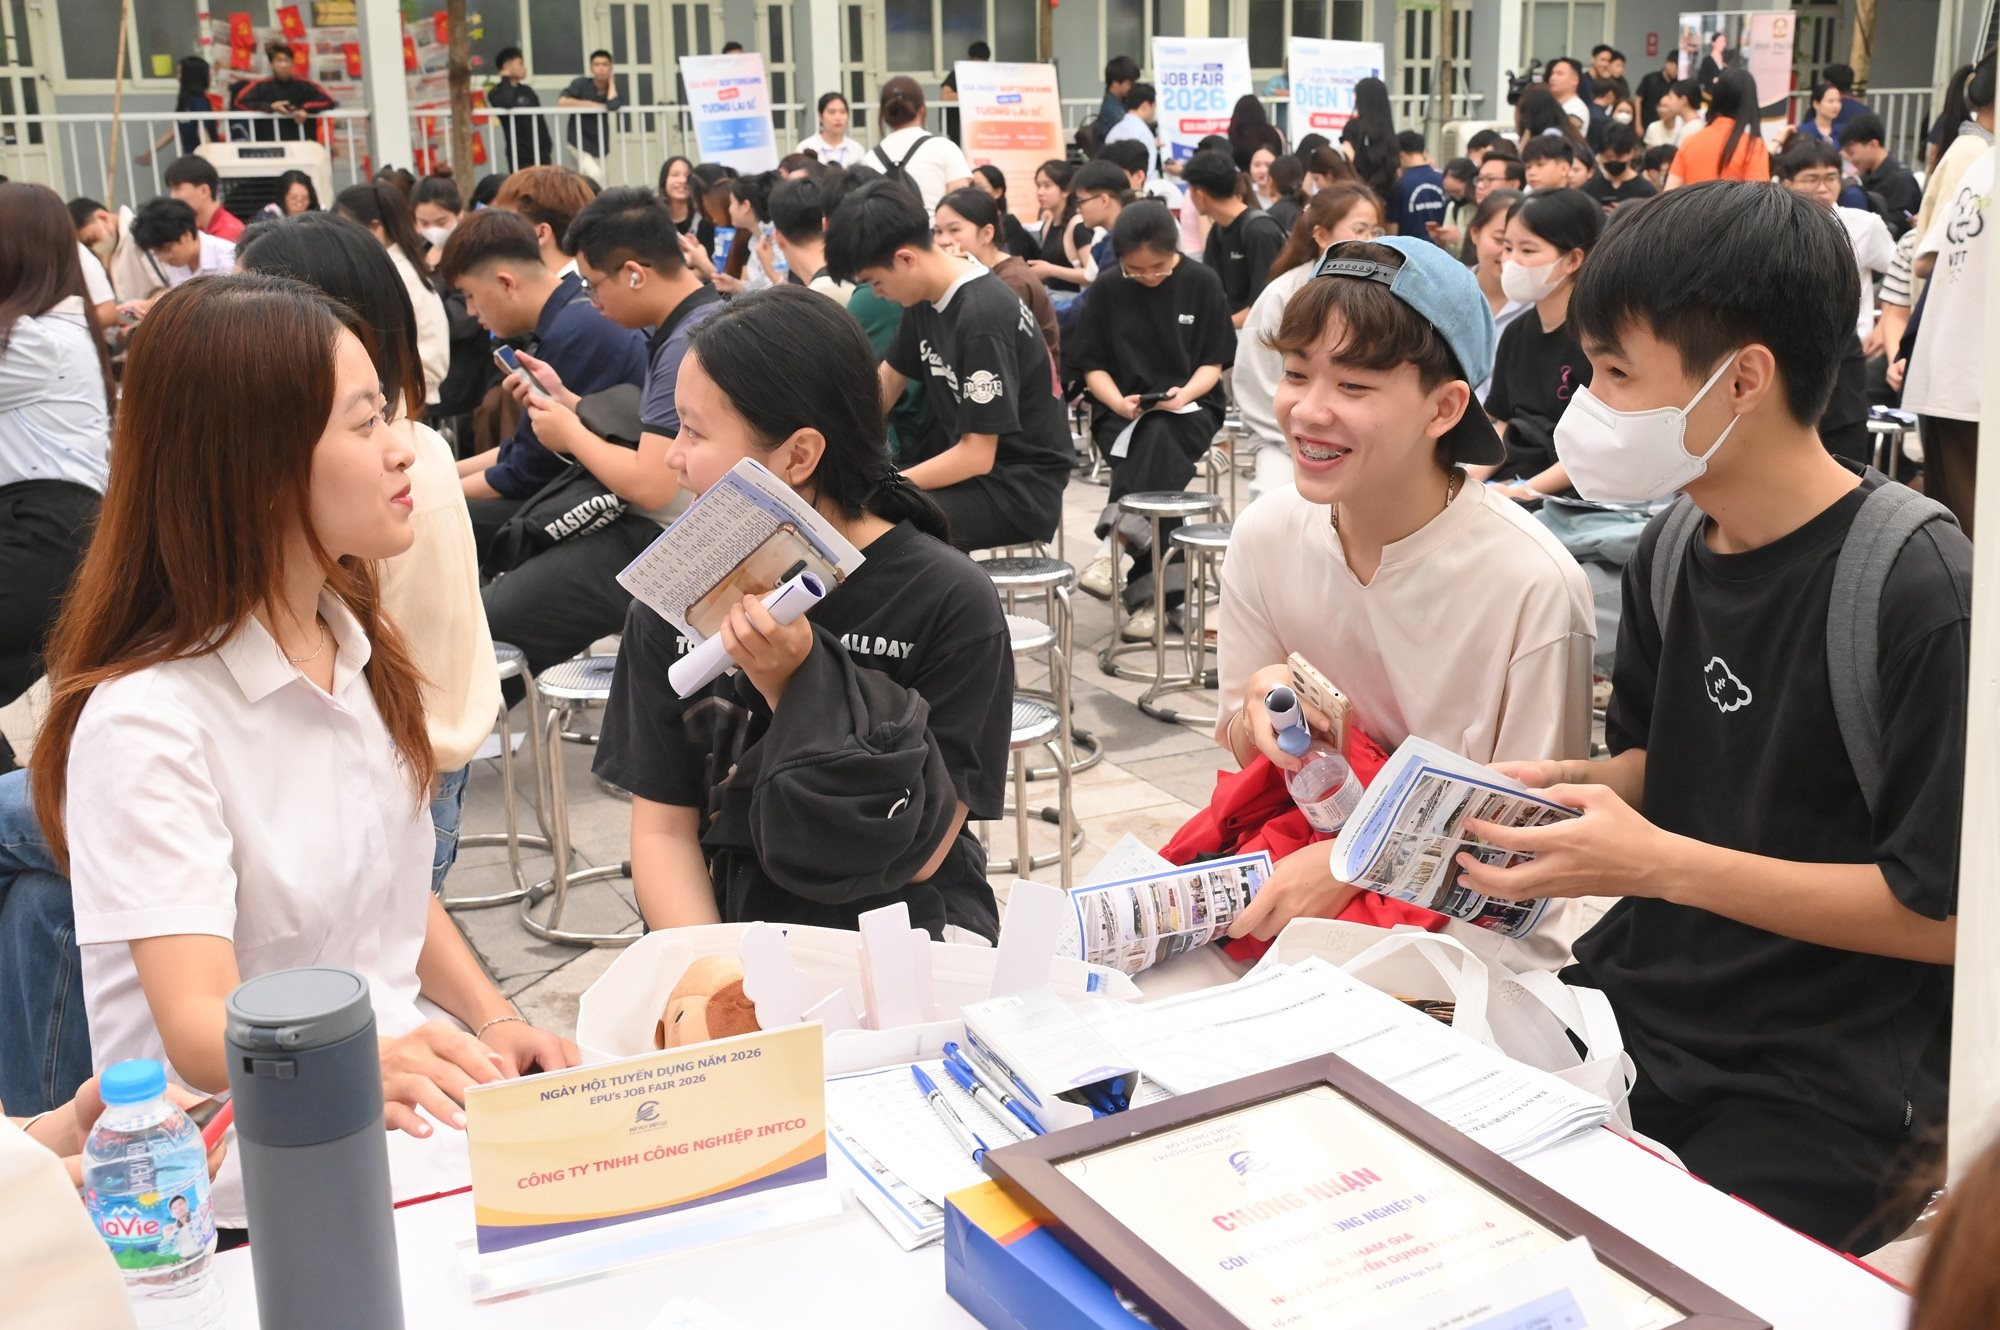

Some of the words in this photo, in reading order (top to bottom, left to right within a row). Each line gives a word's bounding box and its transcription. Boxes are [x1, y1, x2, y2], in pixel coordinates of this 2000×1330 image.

[1161, 72, 1188, 86] JOB
[1192, 72, 1225, 86] FAIR
[1163, 86, 1227, 112] 2026
[544, 493, 620, 541] FASHION
[840, 633, 870, 654] ALL
[873, 636, 915, 659] DAY
[540, 1085, 577, 1101] NGÀY
[581, 1078, 607, 1093] HỘI
[656, 1061, 694, 1078] DỤNG
[698, 1054, 726, 1069] NĂM
[730, 1048, 762, 1062] 2026
[590, 1092, 620, 1105] EPU's
[624, 1087, 645, 1099] JOB
[648, 1080, 676, 1093] FAIR
[679, 1074, 706, 1087] 2026
[517, 1169, 565, 1189] CÔNG
[568, 1163, 589, 1178] TY
[593, 1153, 639, 1172] TNHH
[643, 1143, 689, 1162] CÔNG
[693, 1128, 753, 1151] NGHIỆP
[757, 1118, 806, 1137] INTCO
[1303, 1167, 1382, 1201] NHẬN
[1361, 1197, 1413, 1223] NGHIỆP
[1387, 1231, 1416, 1247] GIA
[1387, 1245, 1430, 1263] DỤNG
